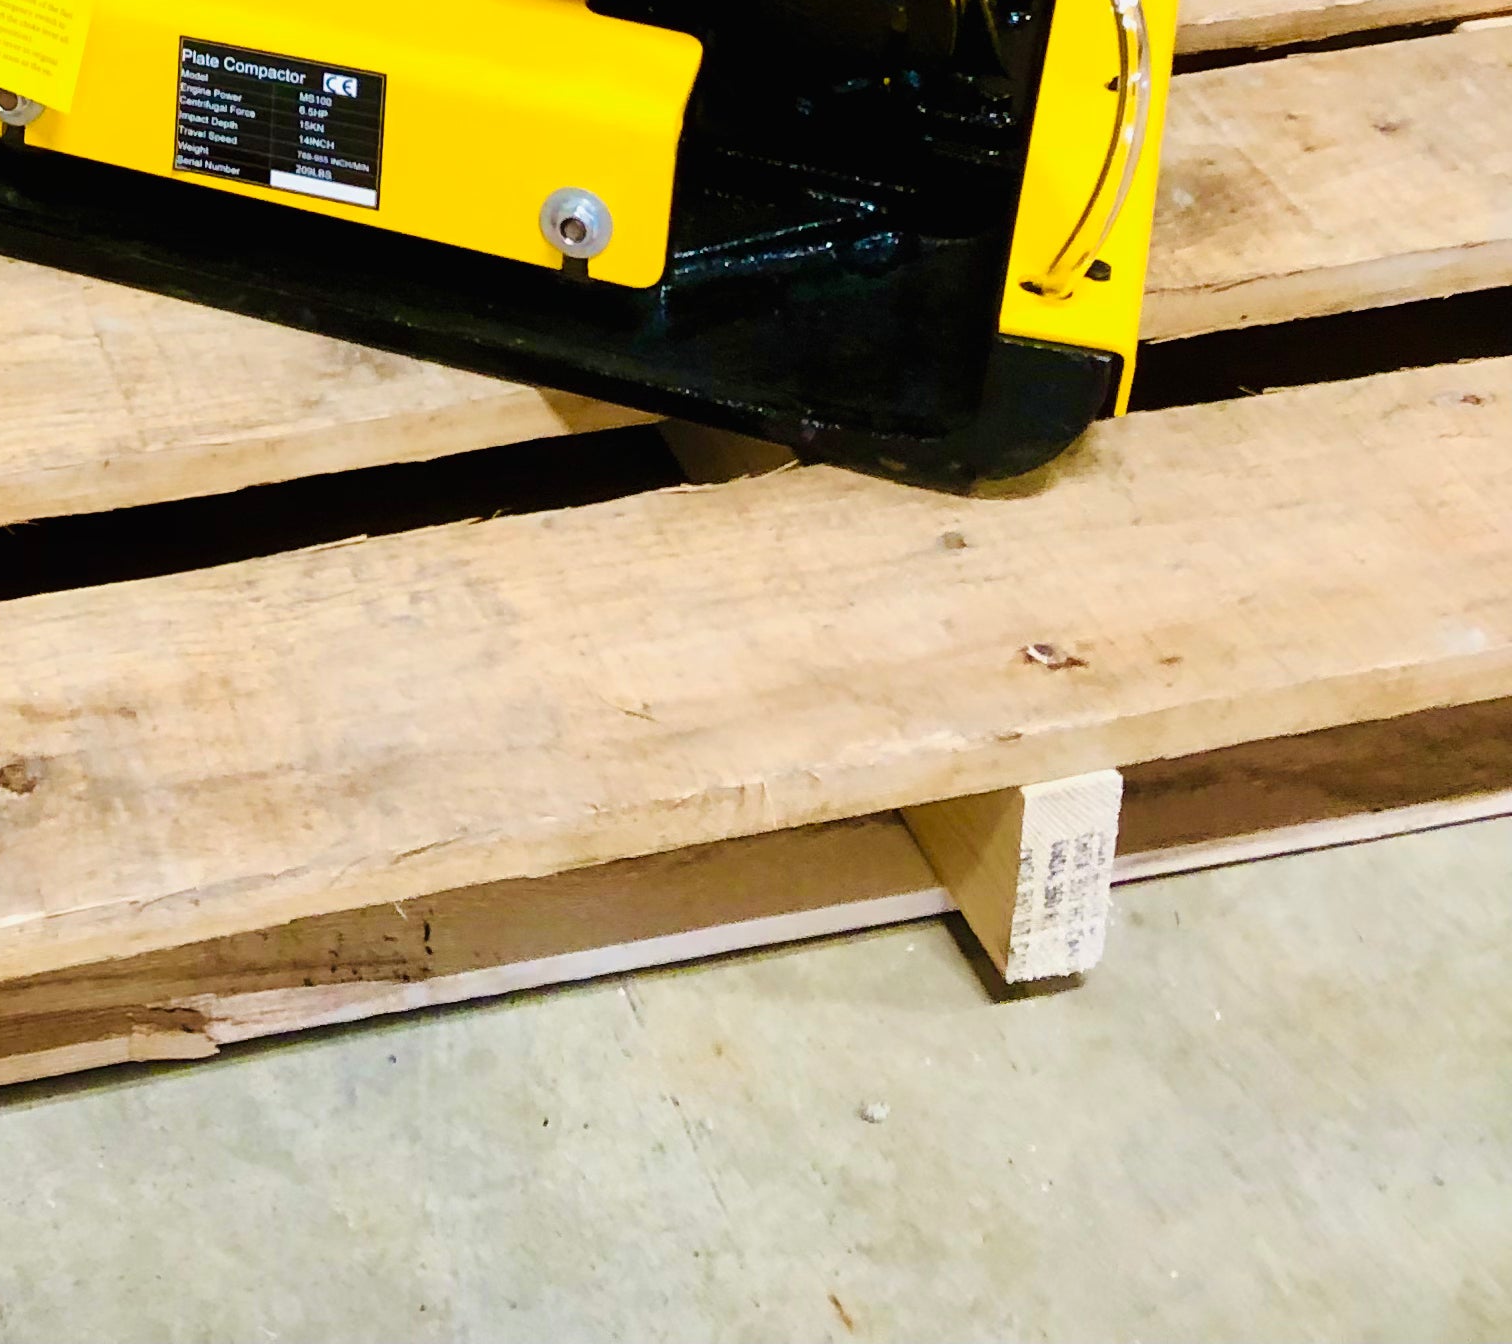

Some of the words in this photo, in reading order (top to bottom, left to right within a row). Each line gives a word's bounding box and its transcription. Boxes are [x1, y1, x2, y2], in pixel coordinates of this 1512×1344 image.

[181, 68, 208, 82] Model
[182, 47, 220, 69] Plate
[223, 56, 307, 85] Compactor
[180, 82, 211, 97] Engine
[213, 88, 242, 102] Power
[179, 95, 228, 113] Centrifugal
[229, 104, 256, 119] Force
[298, 105, 328, 119] 6.5HP
[178, 110, 209, 124] Impact
[211, 116, 238, 130] Depth
[299, 120, 325, 133] 15KN
[179, 124, 207, 139] Travel
[208, 130, 238, 145] Speed
[299, 134, 335, 150] 14INCH
[177, 141, 209, 156] Weight
[176, 154, 203, 168] Serial
[204, 159, 241, 175] Number
